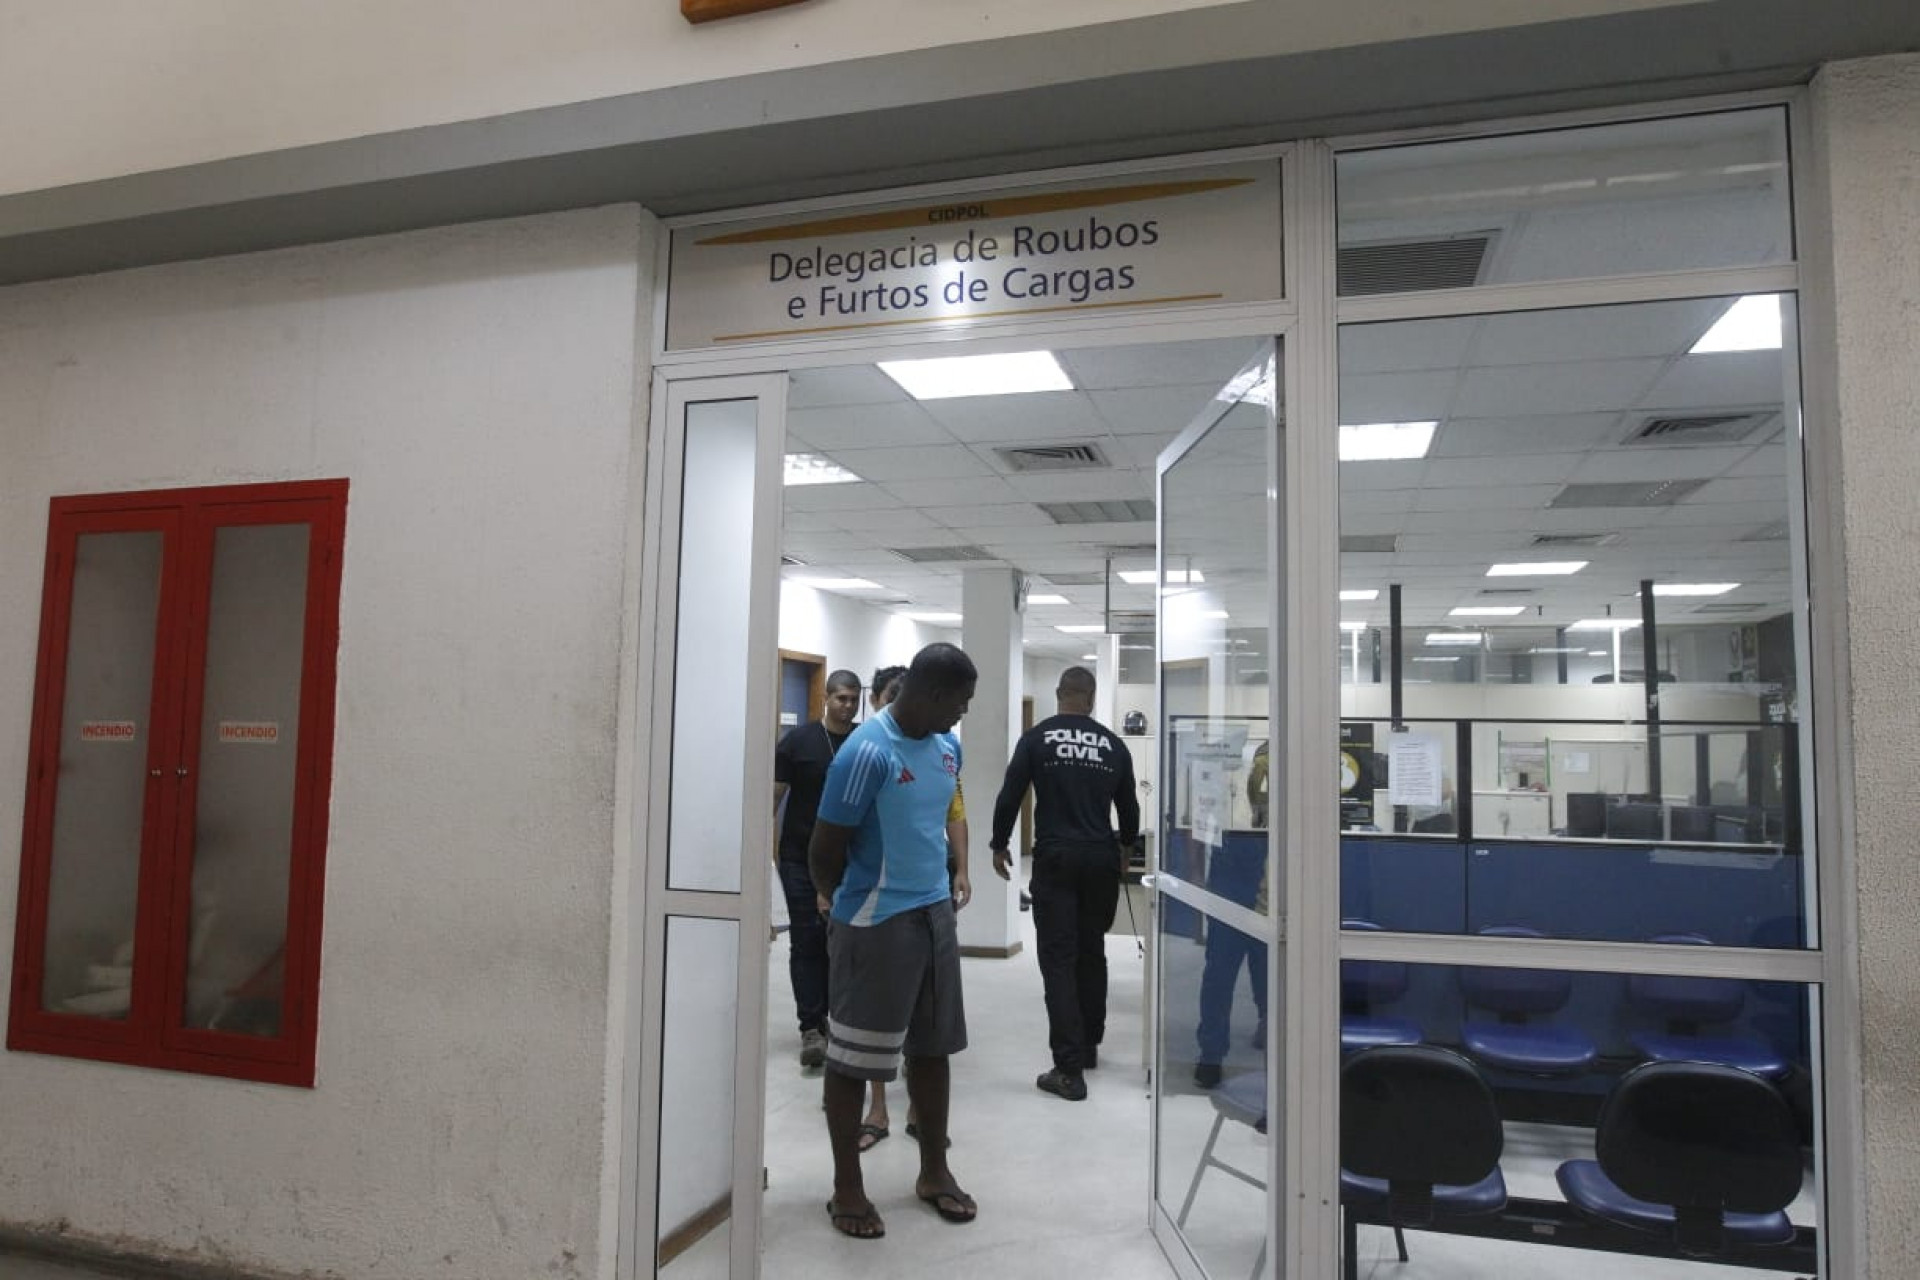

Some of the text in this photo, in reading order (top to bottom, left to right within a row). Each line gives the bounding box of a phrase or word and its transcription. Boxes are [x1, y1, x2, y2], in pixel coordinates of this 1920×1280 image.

[927, 203, 989, 223] CIDPOL
[769, 216, 1159, 284] Delegacia de Roubos
[787, 262, 1135, 319] e Furtos de Cargas
[1056, 744, 1103, 762] CIVIL
